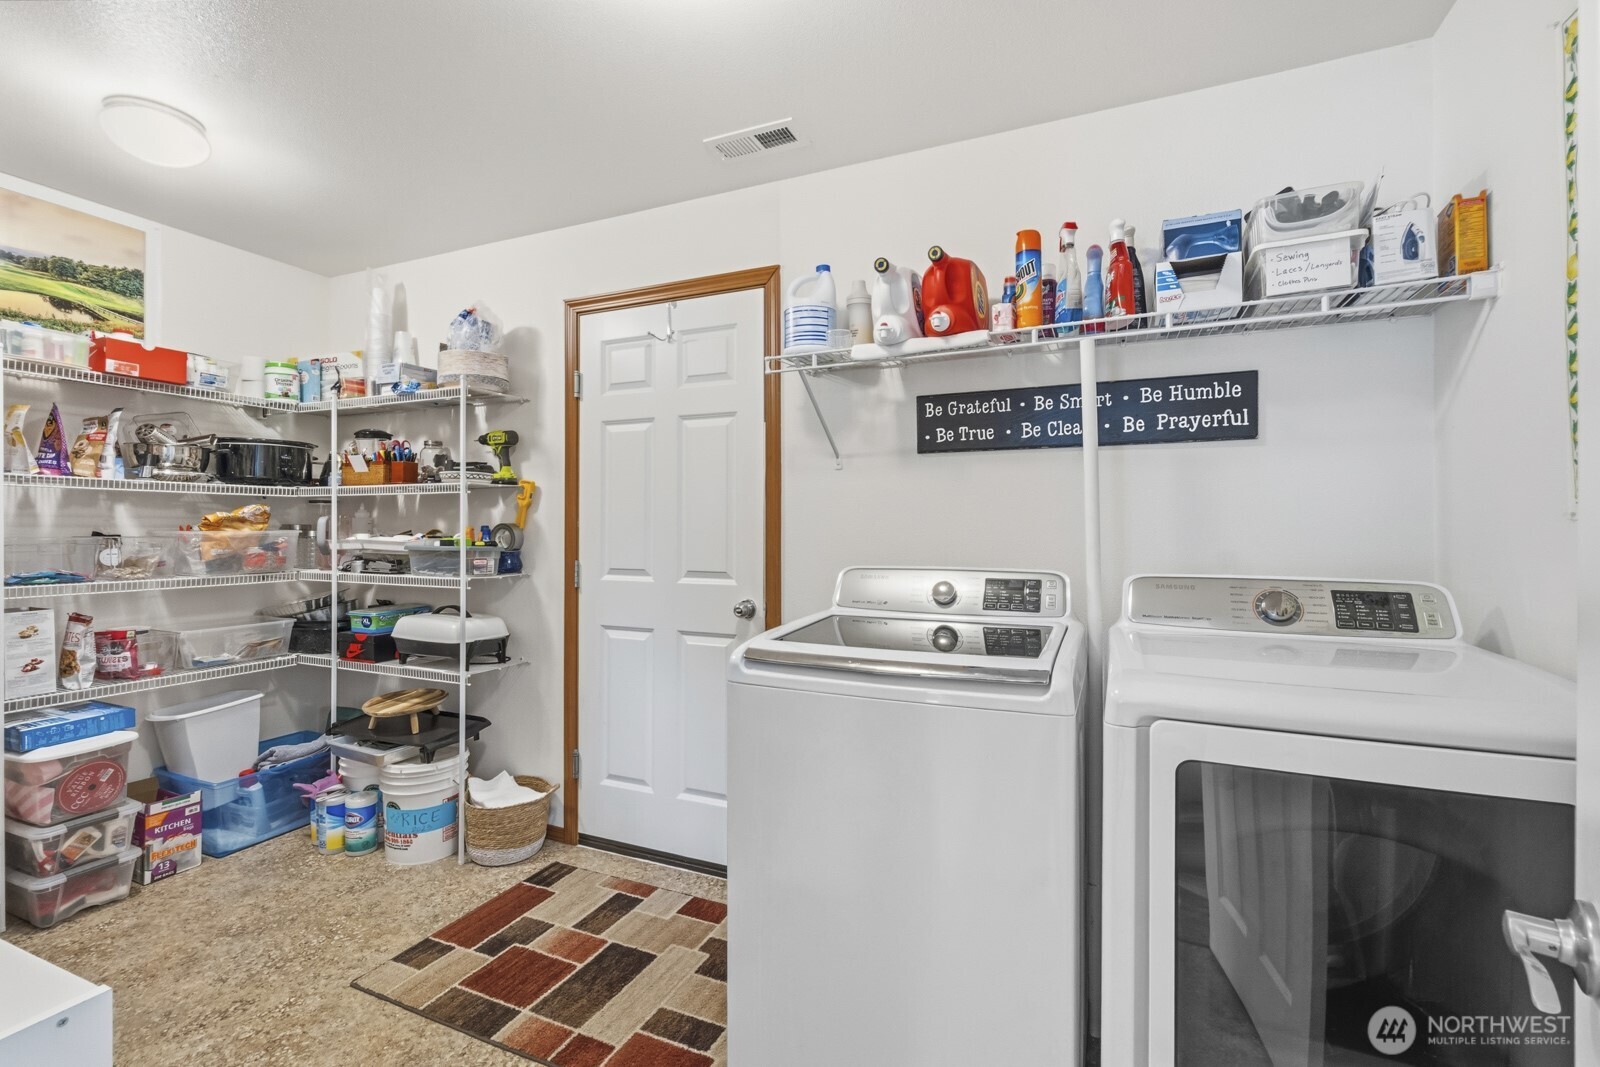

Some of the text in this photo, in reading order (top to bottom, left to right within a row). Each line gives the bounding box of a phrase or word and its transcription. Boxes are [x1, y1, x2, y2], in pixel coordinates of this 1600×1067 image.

[1276, 251, 1310, 262] Sewing
[925, 381, 1242, 418] Be Grateful Be Smrt Be Humble
[936, 408, 1250, 442] Be True Be Clea Be Prayerful
[71, 792, 89, 810] CCC
[154, 818, 192, 834] KITCHEN
[402, 808, 441, 827] RICE
[158, 860, 170, 870] 13
